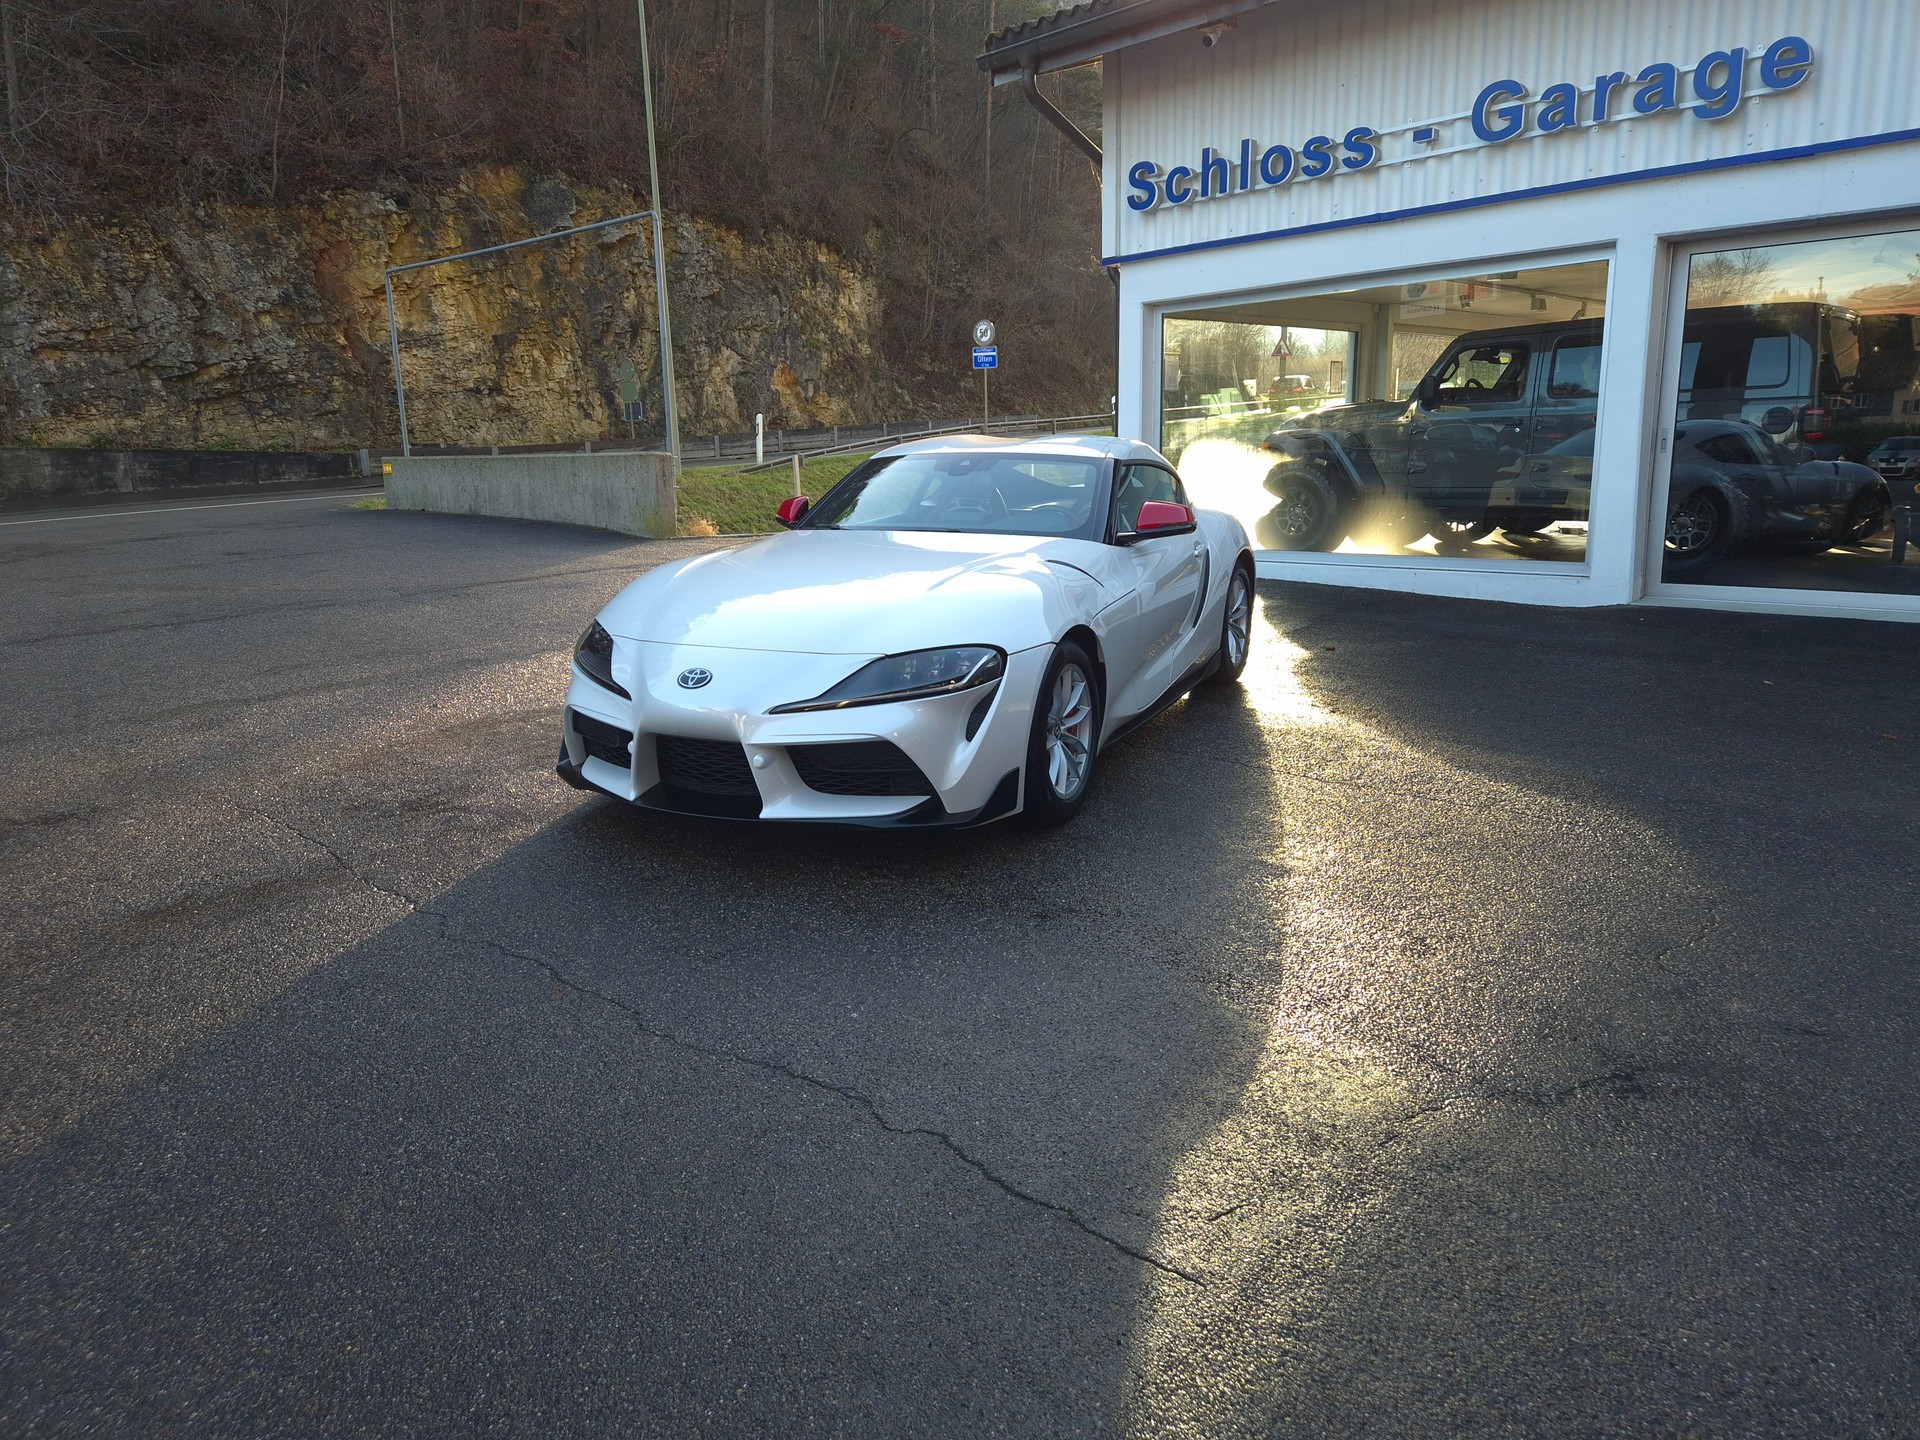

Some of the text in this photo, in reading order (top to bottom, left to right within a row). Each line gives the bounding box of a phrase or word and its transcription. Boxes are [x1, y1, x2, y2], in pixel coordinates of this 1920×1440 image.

[1126, 126, 1378, 212] Schloss
[1471, 36, 1813, 142] Garage
[979, 328, 988, 338] 50
